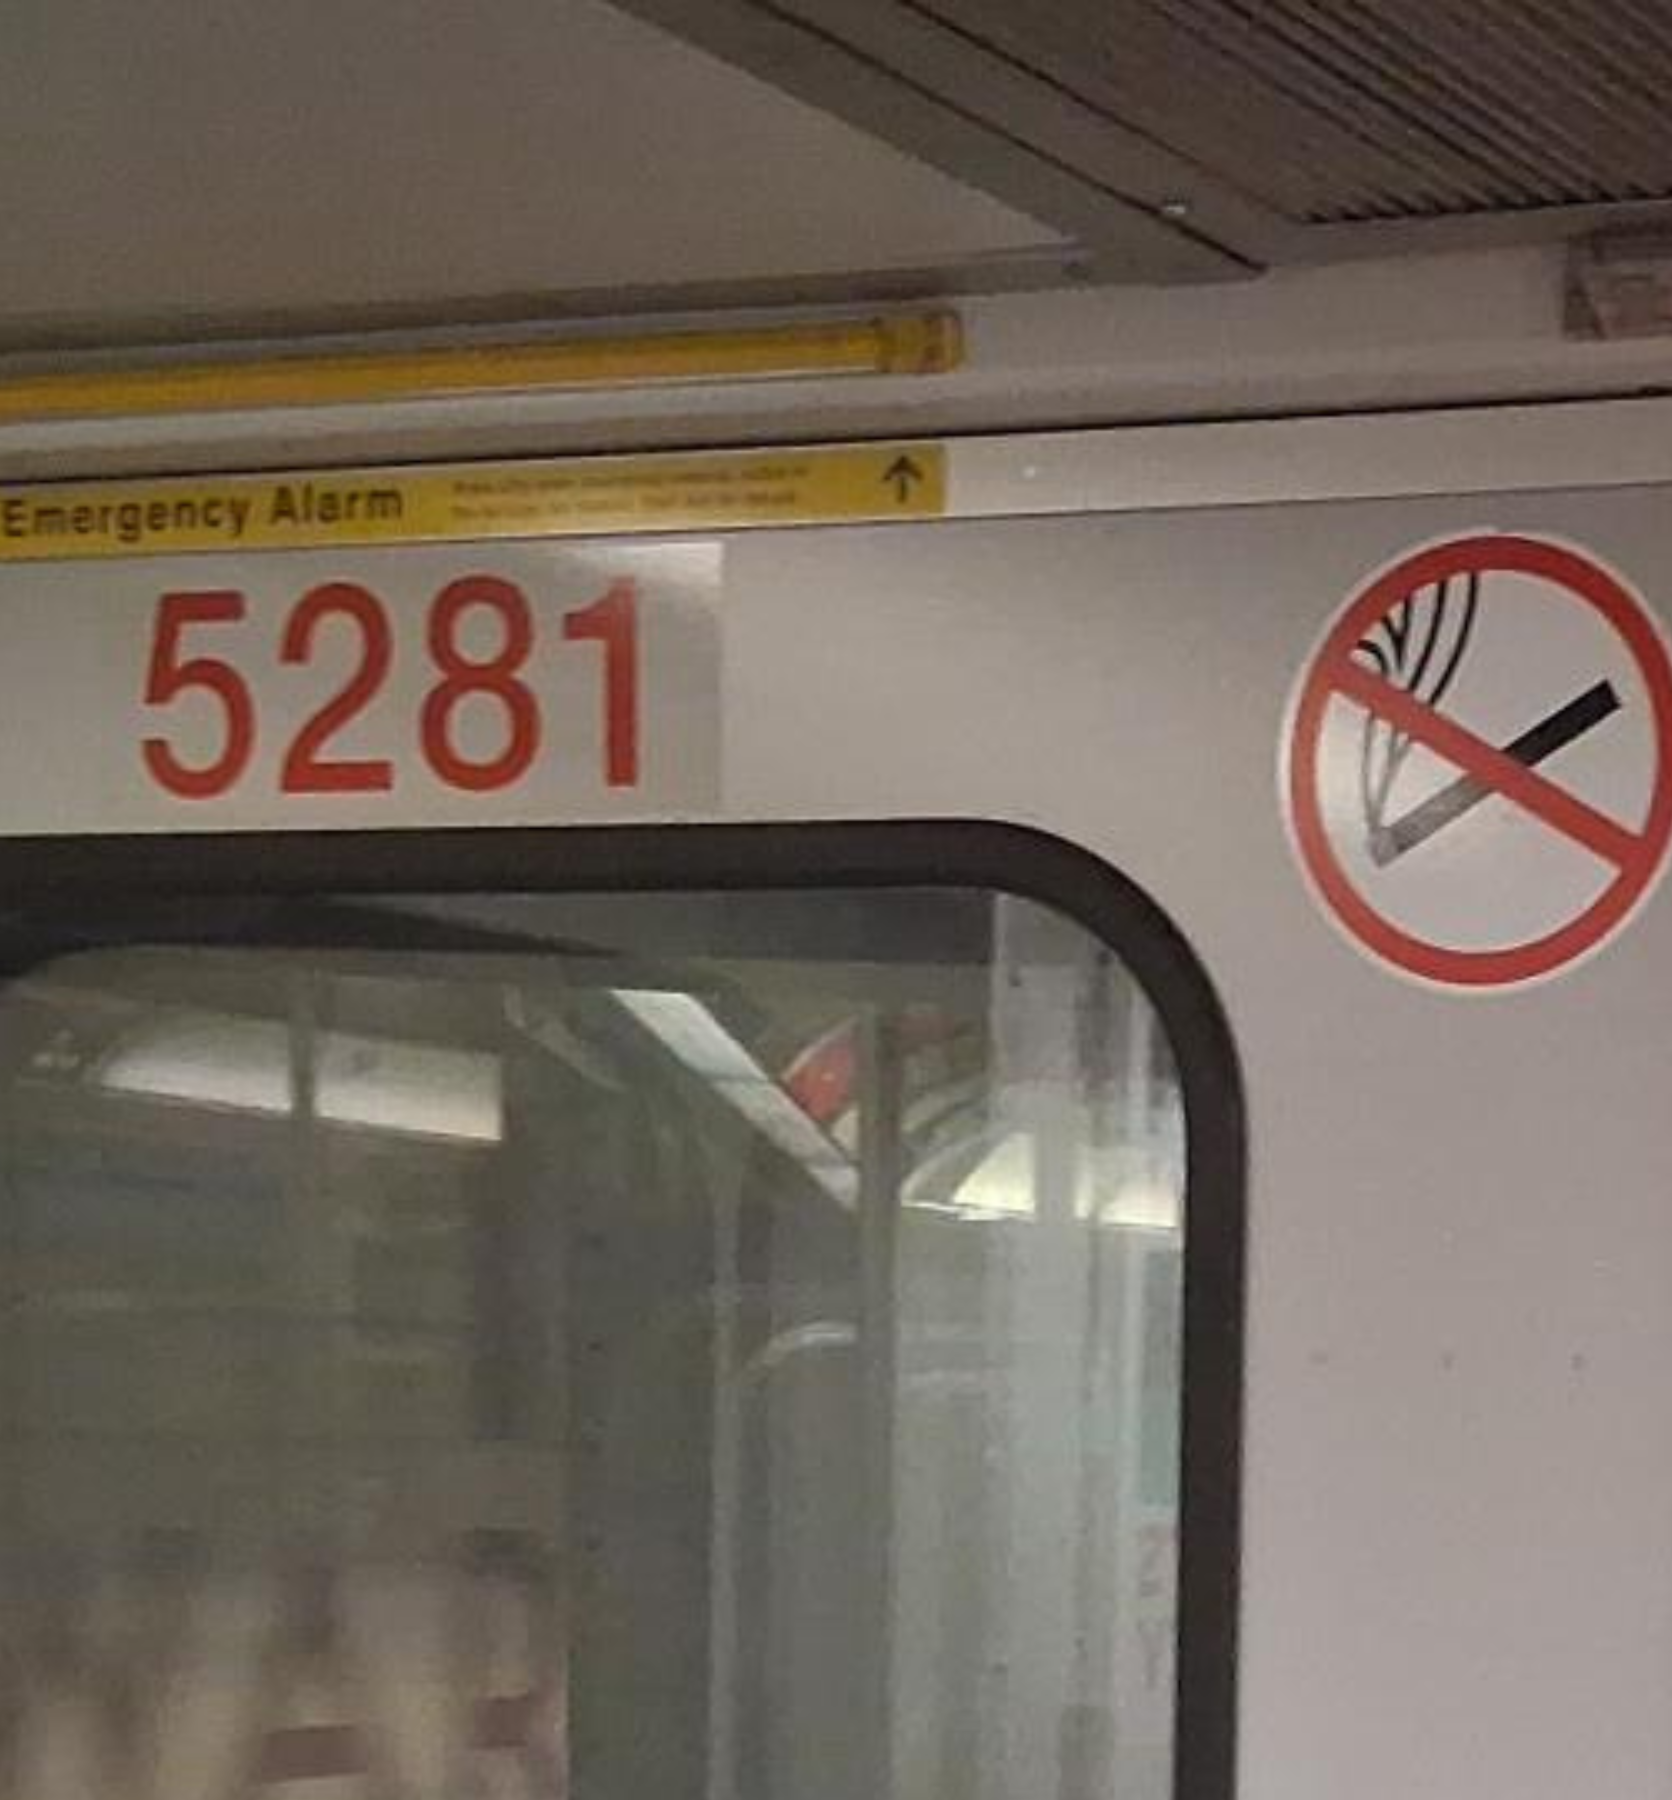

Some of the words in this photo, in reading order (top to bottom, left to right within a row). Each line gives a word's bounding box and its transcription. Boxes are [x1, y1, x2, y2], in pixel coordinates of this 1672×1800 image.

[0, 497, 252, 542] Emergency
[268, 481, 403, 524] Alarm
[142, 573, 640, 798] 5281
